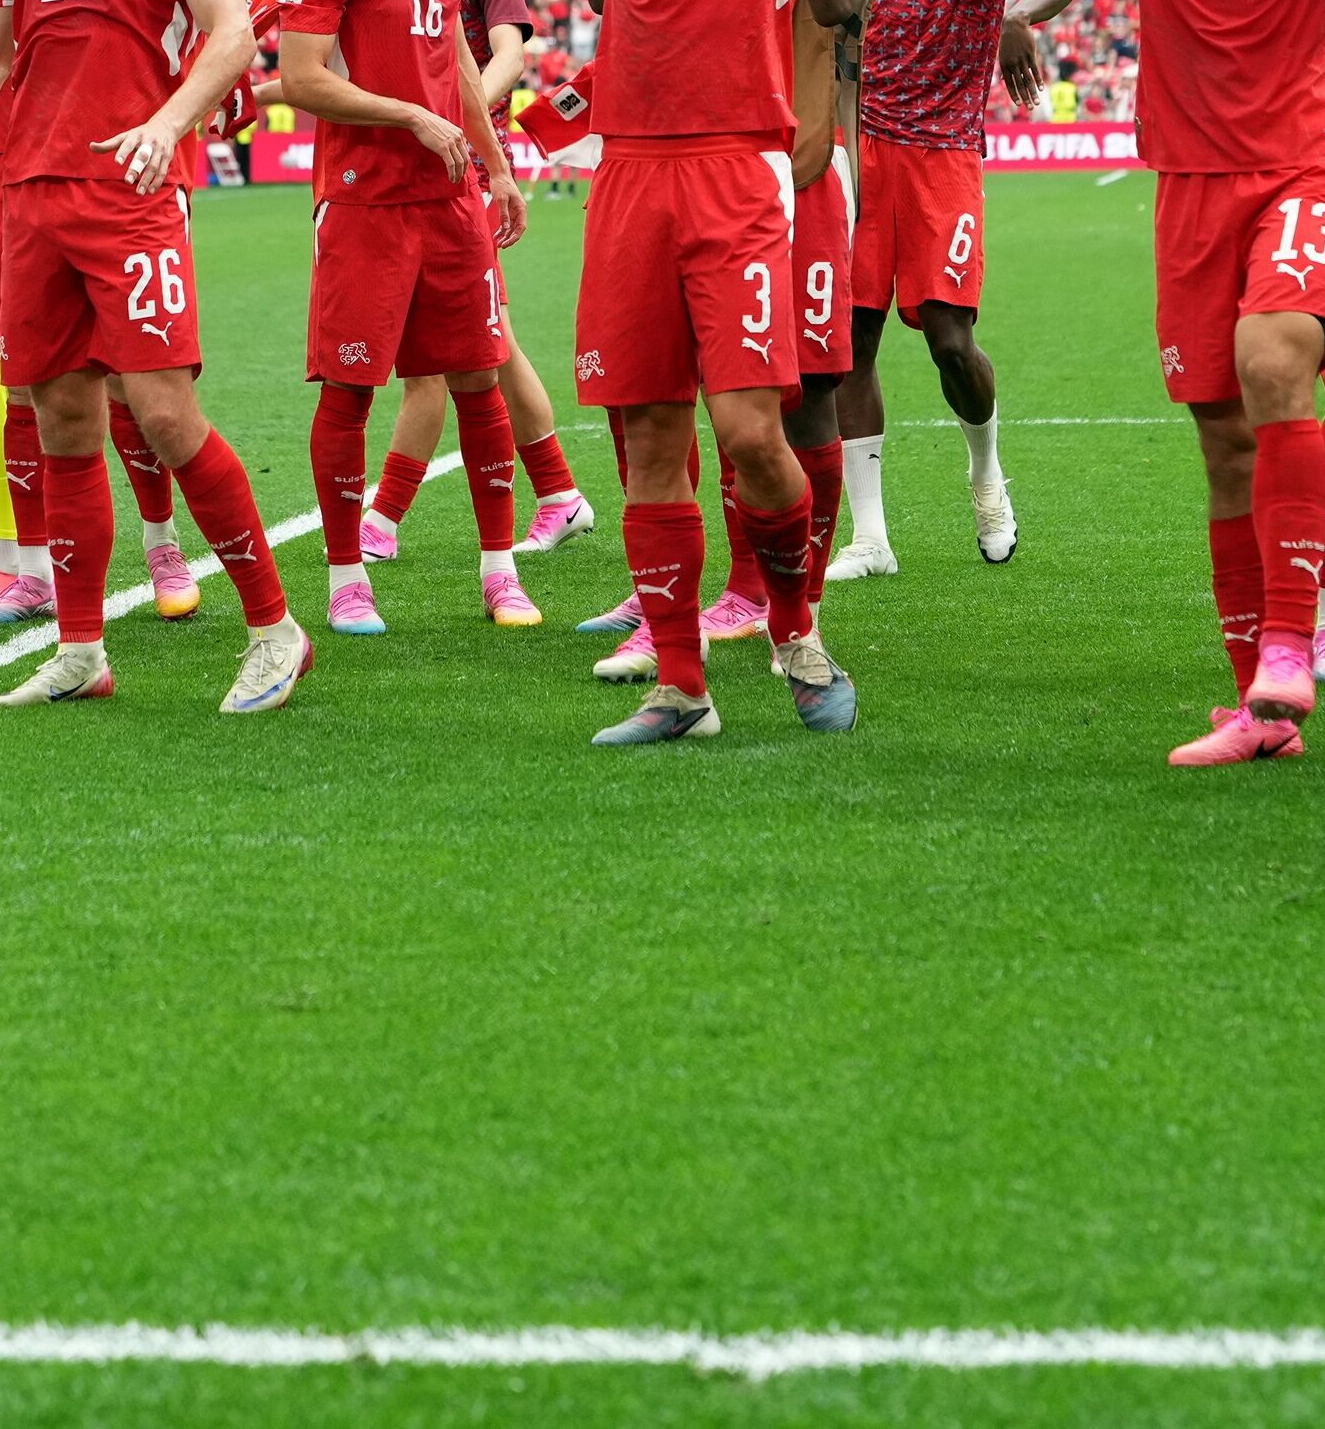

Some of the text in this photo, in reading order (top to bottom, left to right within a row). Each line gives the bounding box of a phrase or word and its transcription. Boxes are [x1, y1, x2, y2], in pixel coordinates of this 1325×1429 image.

[1037, 134, 1099, 160] FIFA
[947, 212, 976, 264] 6
[124, 249, 187, 320] 26
[742, 262, 772, 334] 3
[805, 261, 834, 325] 9
